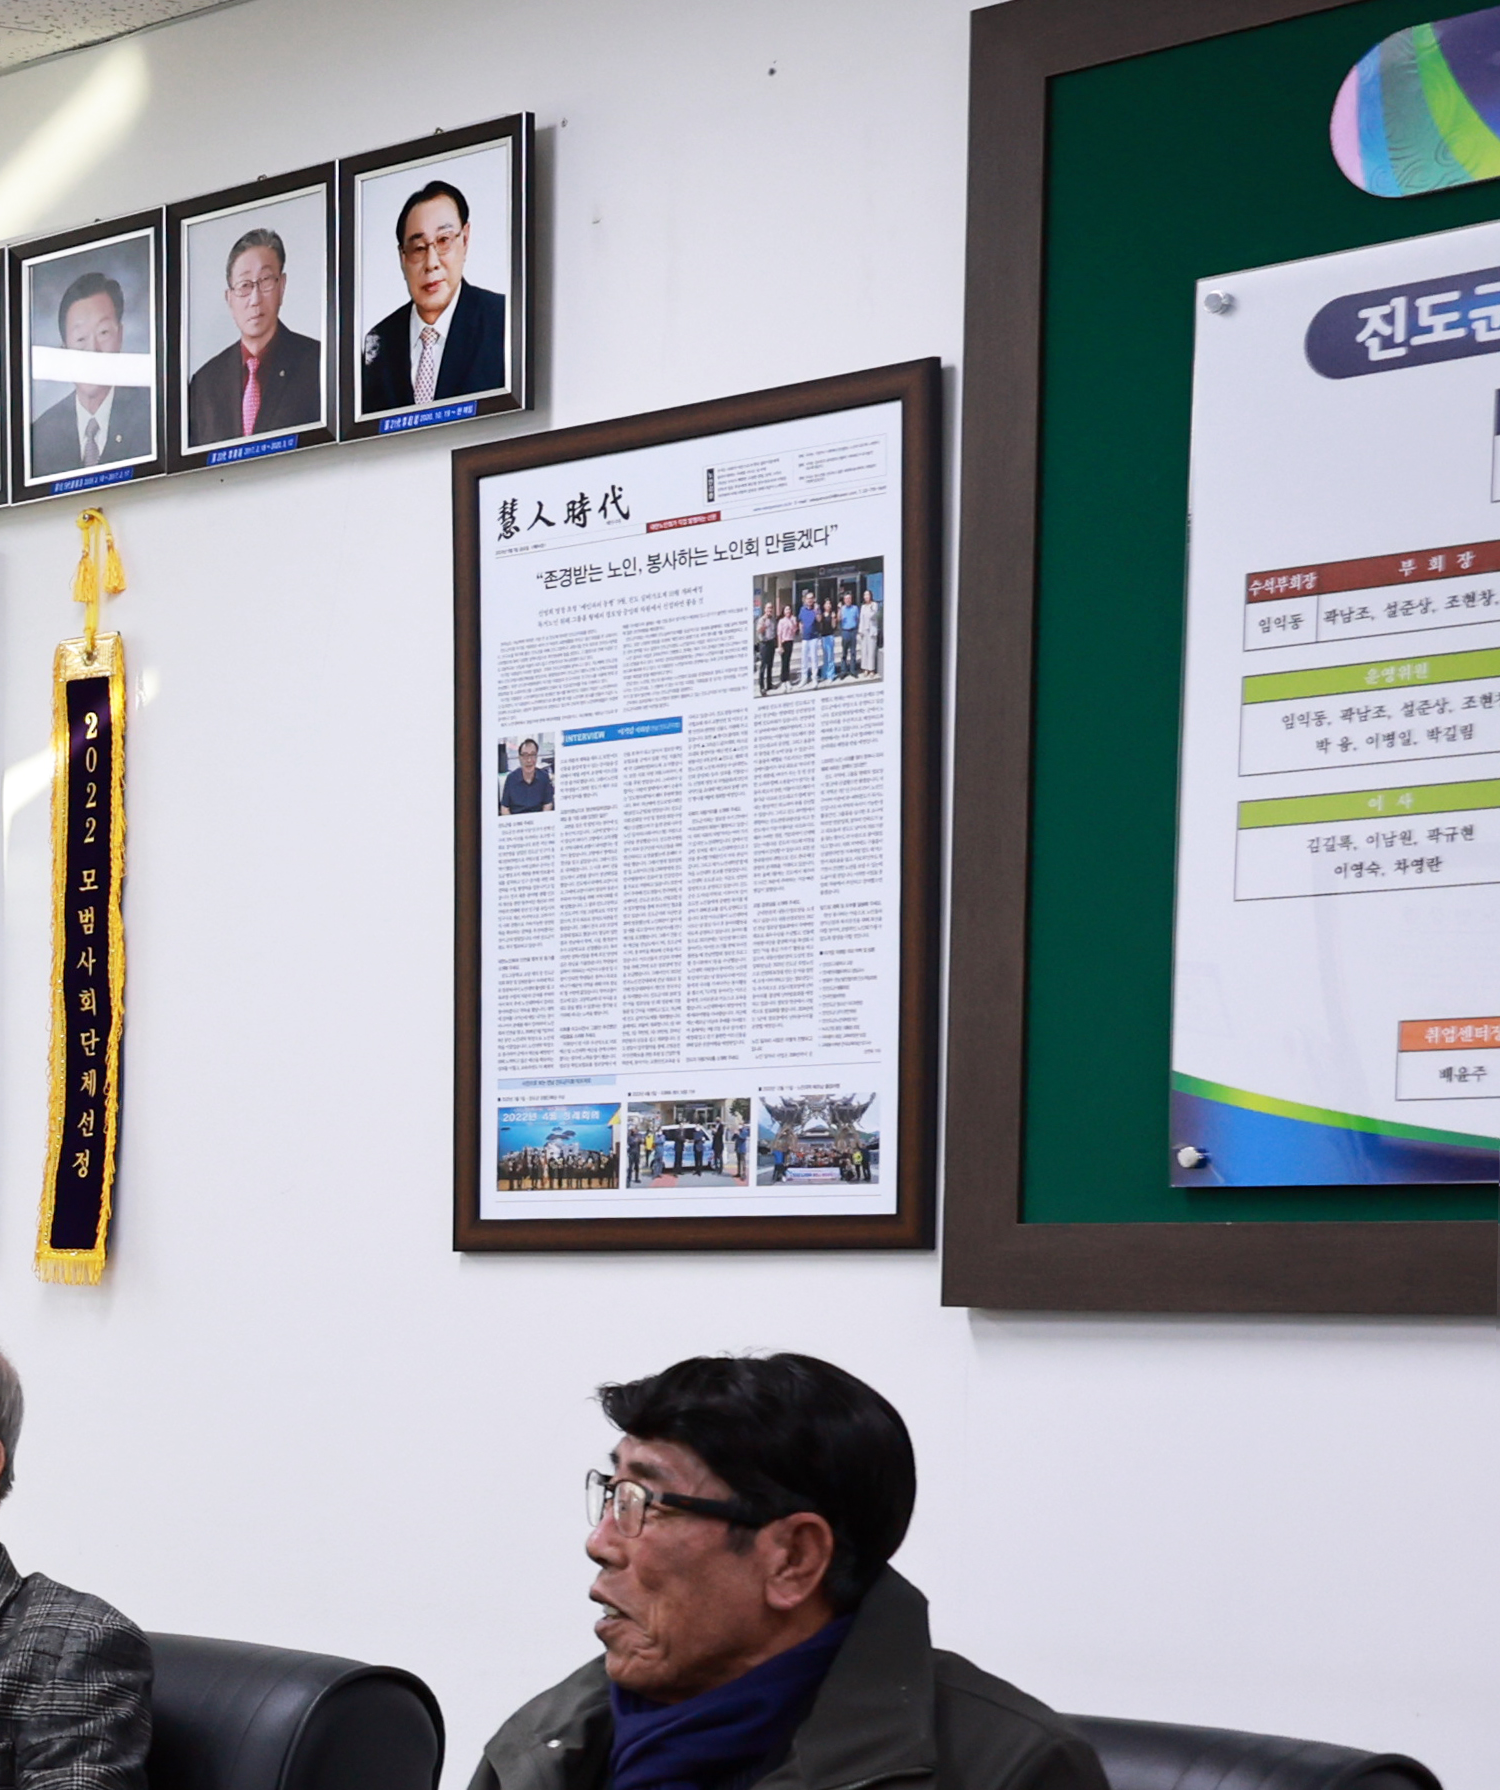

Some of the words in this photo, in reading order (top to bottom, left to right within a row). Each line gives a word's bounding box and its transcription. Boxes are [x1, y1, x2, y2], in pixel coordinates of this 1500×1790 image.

[497, 484, 630, 542] 慧人時代
[607, 556, 643, 580] 노인,
[646, 548, 709, 573] 봉사하는
[712, 537, 760, 561] 노인회
[765, 524, 839, 555] 만들겠다”
[1248, 573, 1318, 595] 수석부회장
[1323, 607, 1375, 625] 곽남조,
[564, 731, 605, 743] INTERVIEW
[83, 711, 99, 846] 2022
